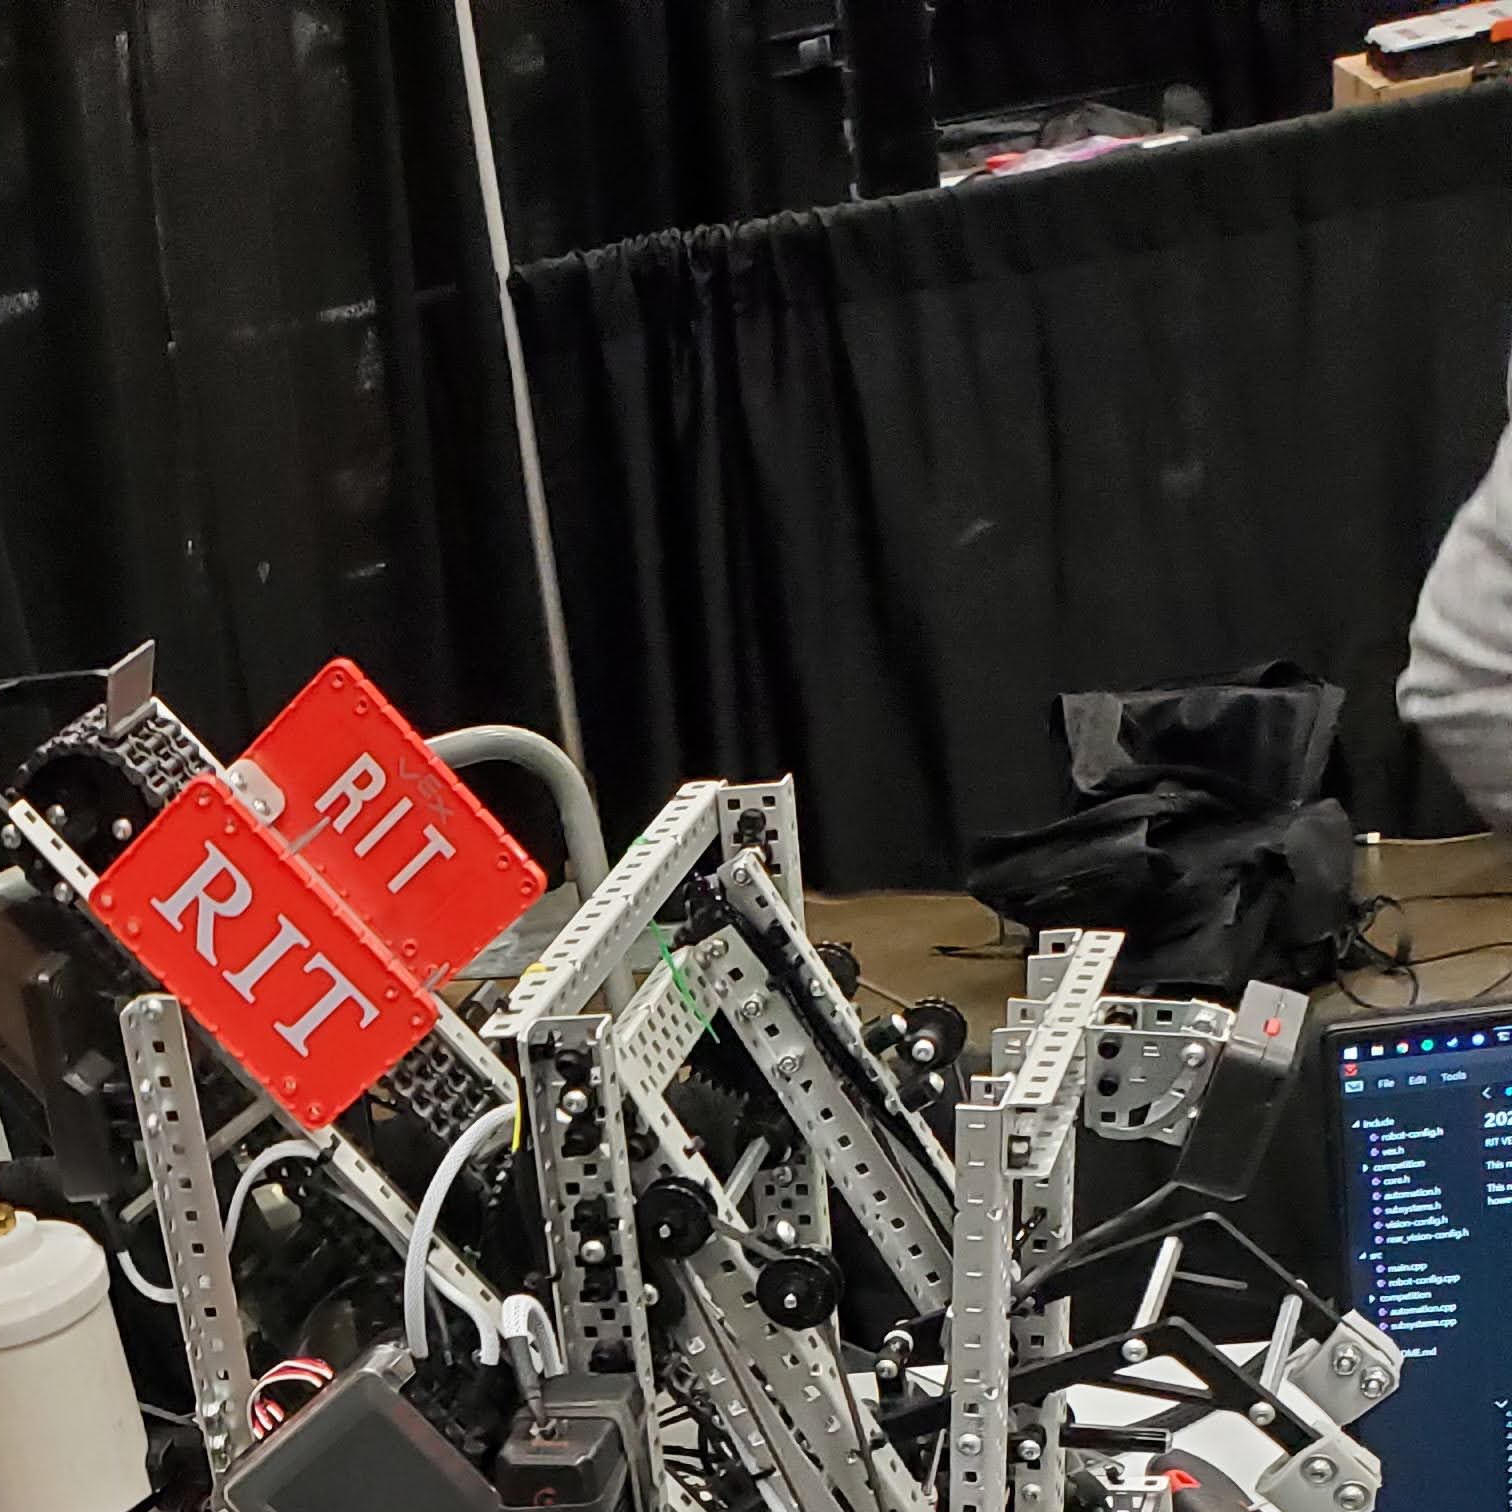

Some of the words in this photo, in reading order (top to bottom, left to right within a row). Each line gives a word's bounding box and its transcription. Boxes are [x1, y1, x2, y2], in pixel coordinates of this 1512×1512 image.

[314, 752, 456, 894] RIT
[399, 756, 455, 824] VEX
[150, 839, 380, 1057] RIT
[1378, 1079, 1395, 1088] File
[1408, 1076, 1427, 1086] Edit
[1441, 1071, 1467, 1082] Tools
